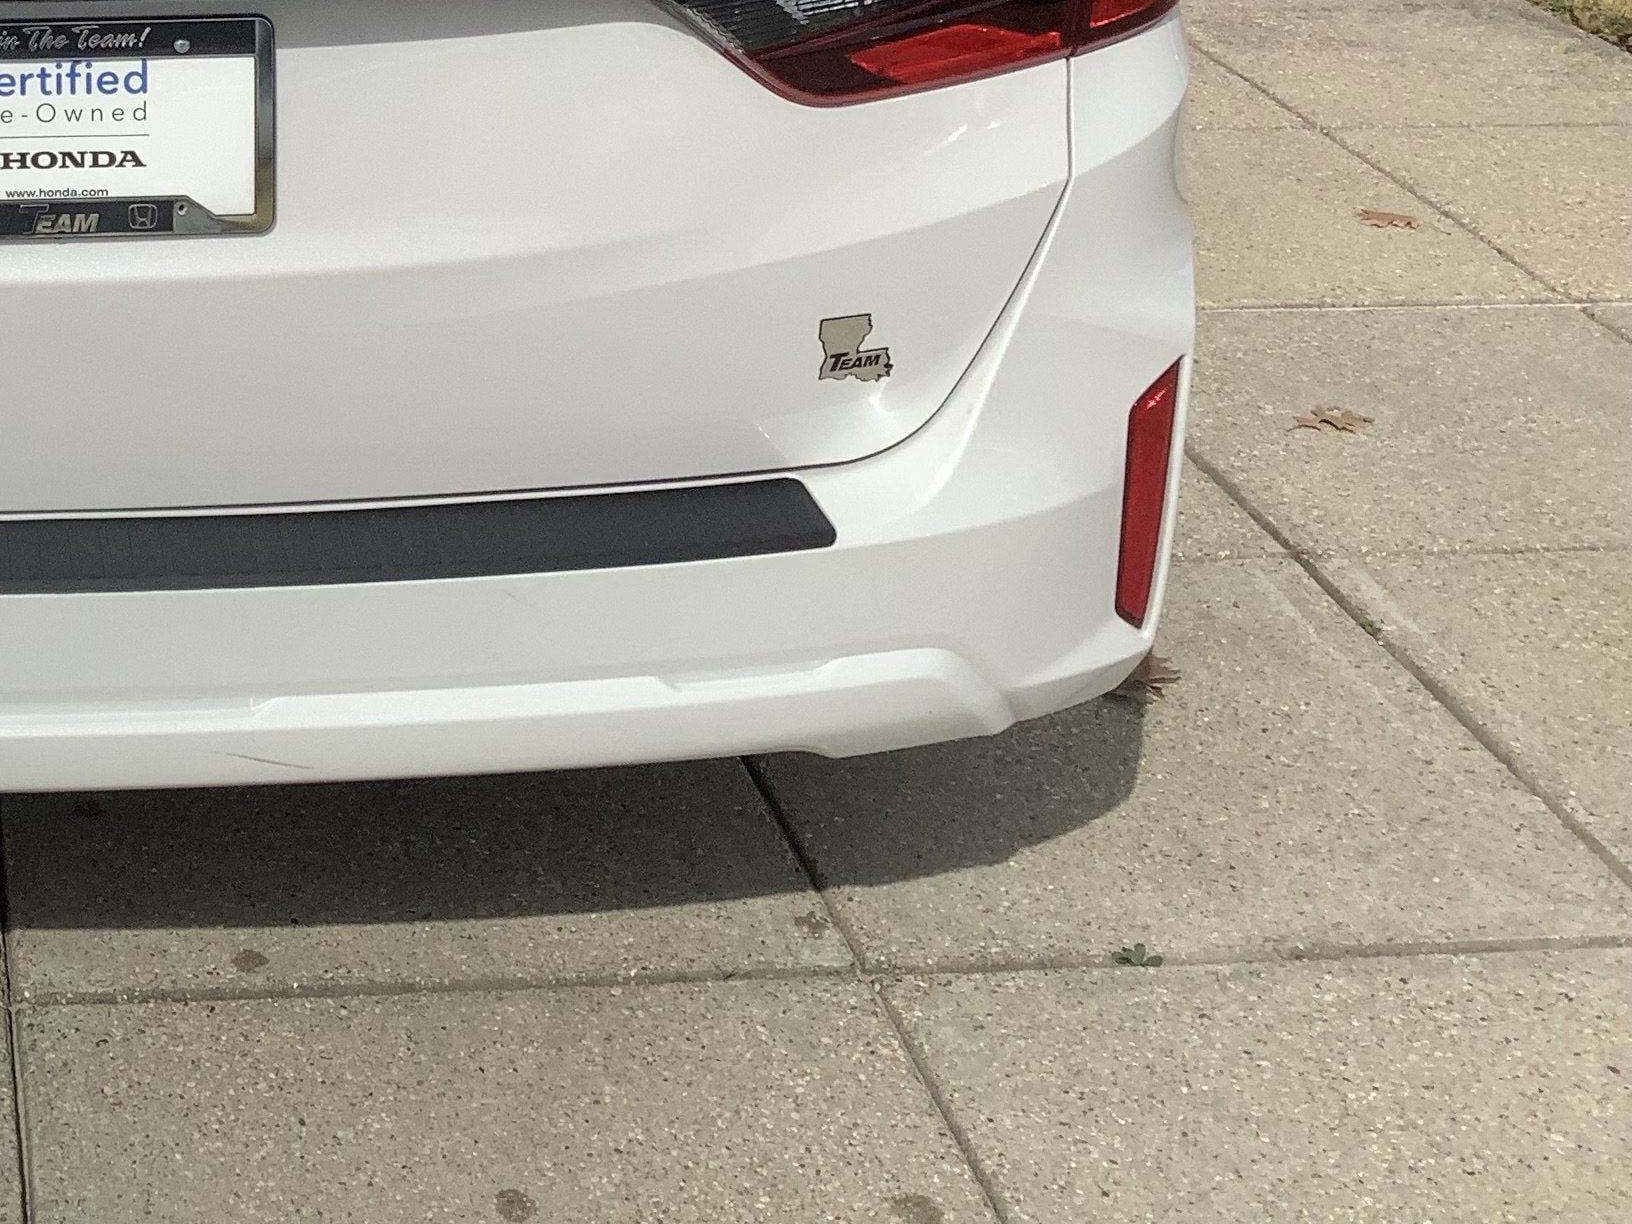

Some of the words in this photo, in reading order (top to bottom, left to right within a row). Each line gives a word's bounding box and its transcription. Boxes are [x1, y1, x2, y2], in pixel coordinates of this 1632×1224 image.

[22, 26, 69, 51] The
[71, 26, 152, 50] Team!
[0, 150, 147, 170] HONDA
[5, 188, 109, 199] www.honda.com
[19, 203, 100, 235] TEAM
[829, 352, 882, 373] TEAM
